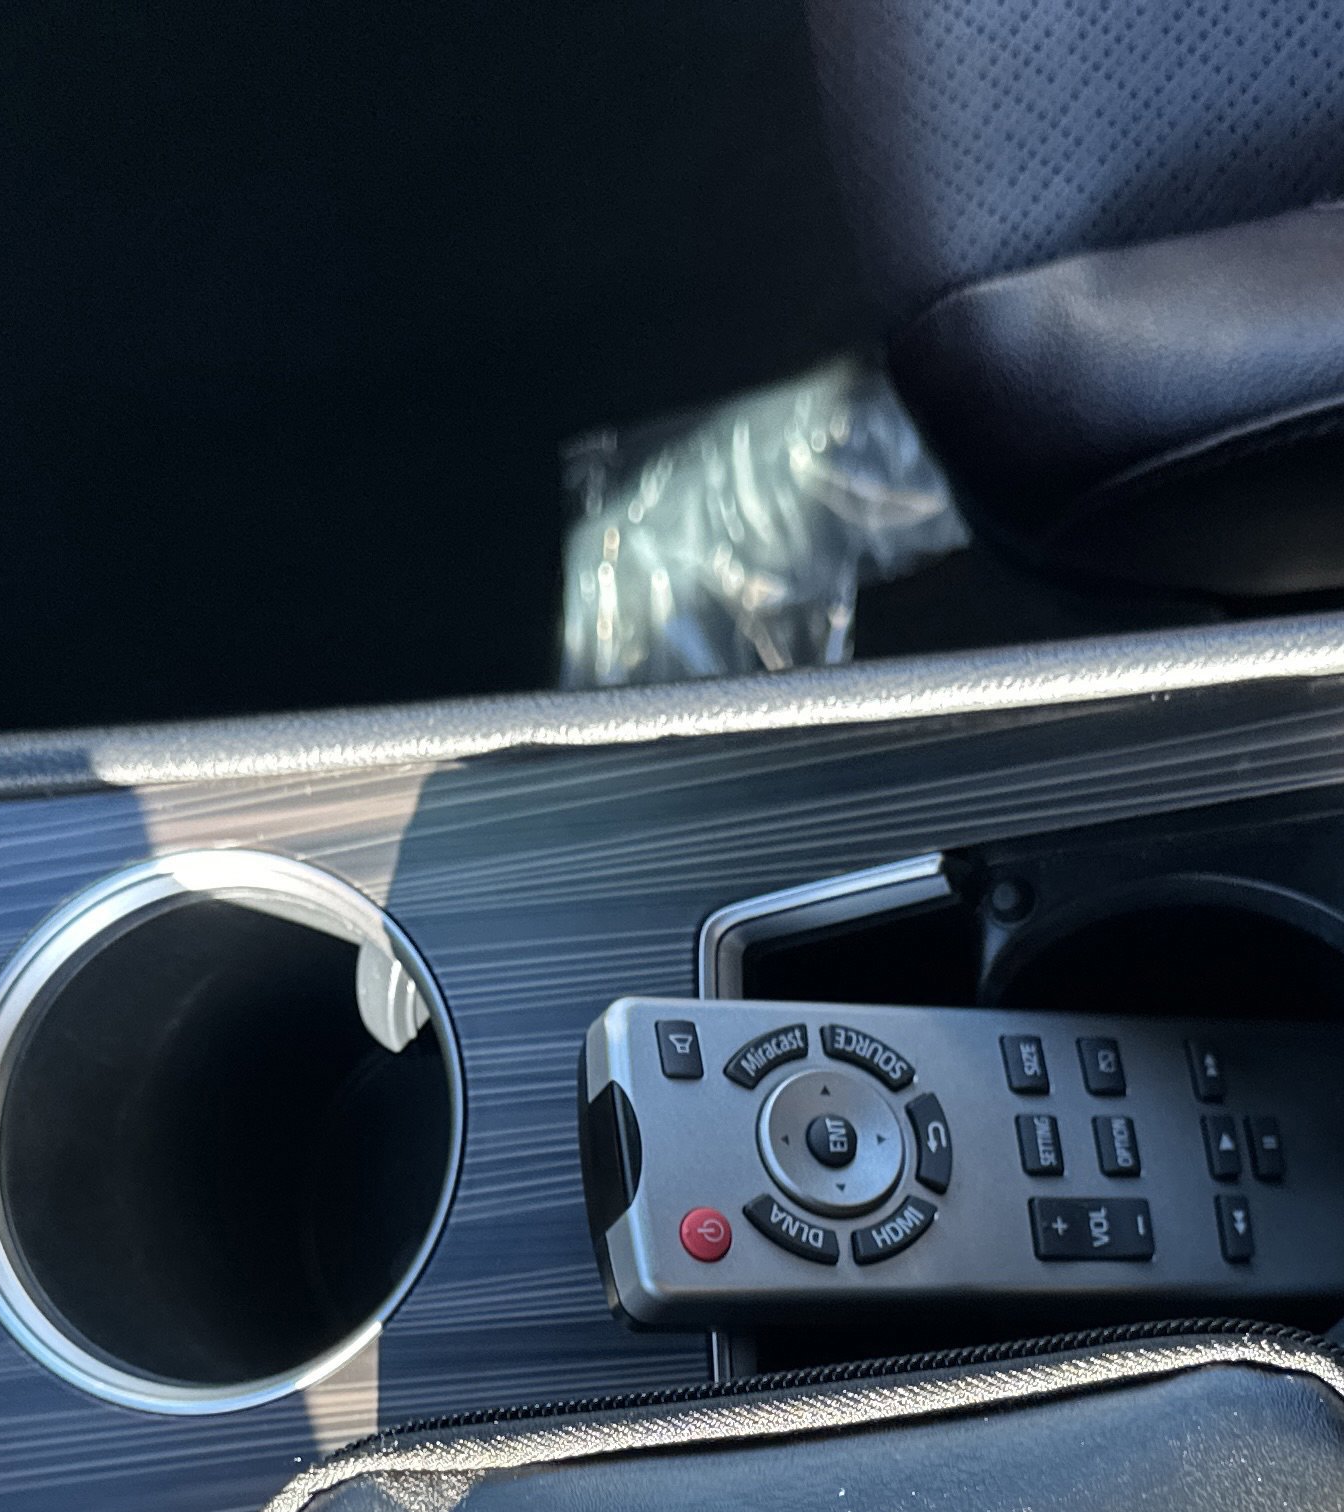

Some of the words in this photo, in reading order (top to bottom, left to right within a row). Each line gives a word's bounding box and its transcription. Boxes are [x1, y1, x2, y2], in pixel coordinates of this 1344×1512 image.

[740, 1027, 804, 1077] Miracast
[834, 1027, 907, 1079] SOURCE
[1020, 1042, 1040, 1076] SIZE
[825, 1117, 848, 1152] ENT
[1034, 1116, 1057, 1166] SETTING
[1111, 1118, 1133, 1167] OPTION
[770, 1203, 824, 1249] DLNA
[872, 1206, 924, 1249] HDMI
[1089, 1207, 1110, 1248] VOL
